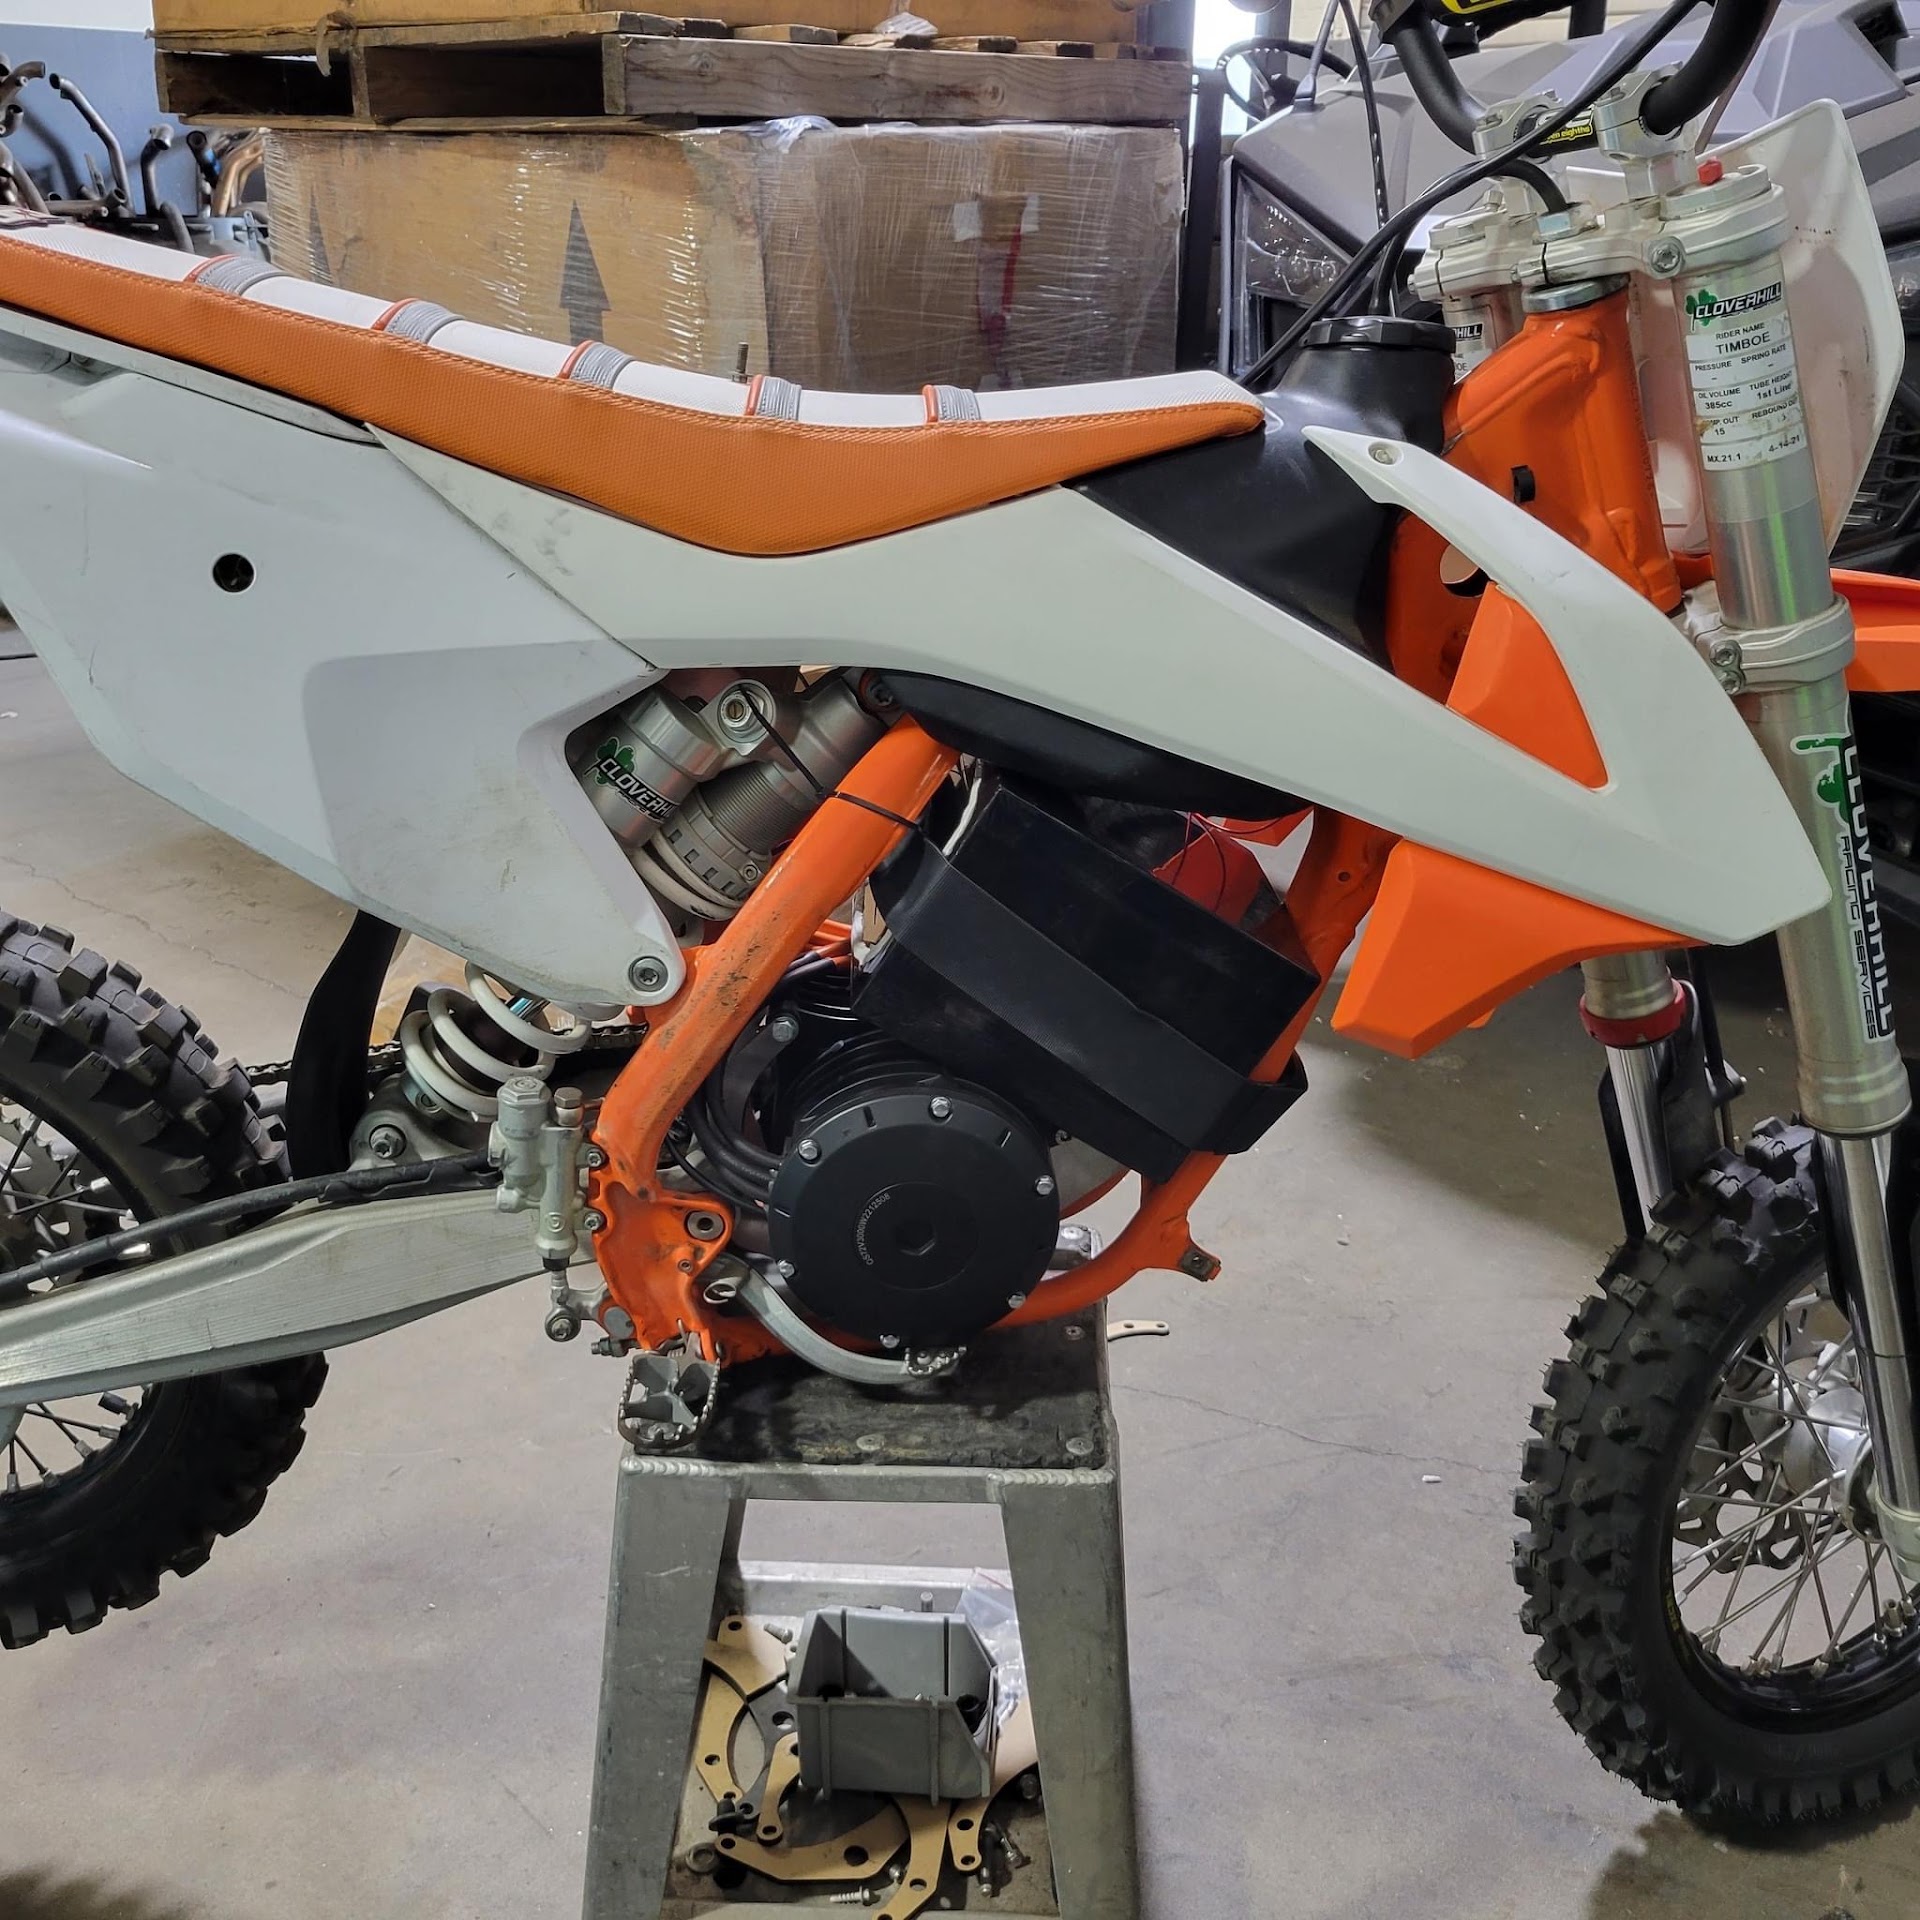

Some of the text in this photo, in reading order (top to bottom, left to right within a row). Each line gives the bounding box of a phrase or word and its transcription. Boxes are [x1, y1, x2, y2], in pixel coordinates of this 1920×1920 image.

[1695, 282, 1782, 319] CLOVERHILL
[1715, 322, 1765, 340] RIDER NAME
[1715, 331, 1771, 354] TIMBOE
[1694, 343, 1786, 371] PRESSURE SPRING RATE
[1709, 387, 1741, 398] VOLUME
[1749, 379, 1770, 391] TUBE
[1771, 370, 1793, 383] HEIGHT
[1705, 400, 1733, 410] 385cc
[1757, 389, 1772, 400] 1st
[1723, 416, 1740, 424] OUT
[1751, 403, 1788, 419] REBOUND
[1714, 427, 1726, 436] 15
[1841, 836, 1878, 1040] RACING SERVICES
